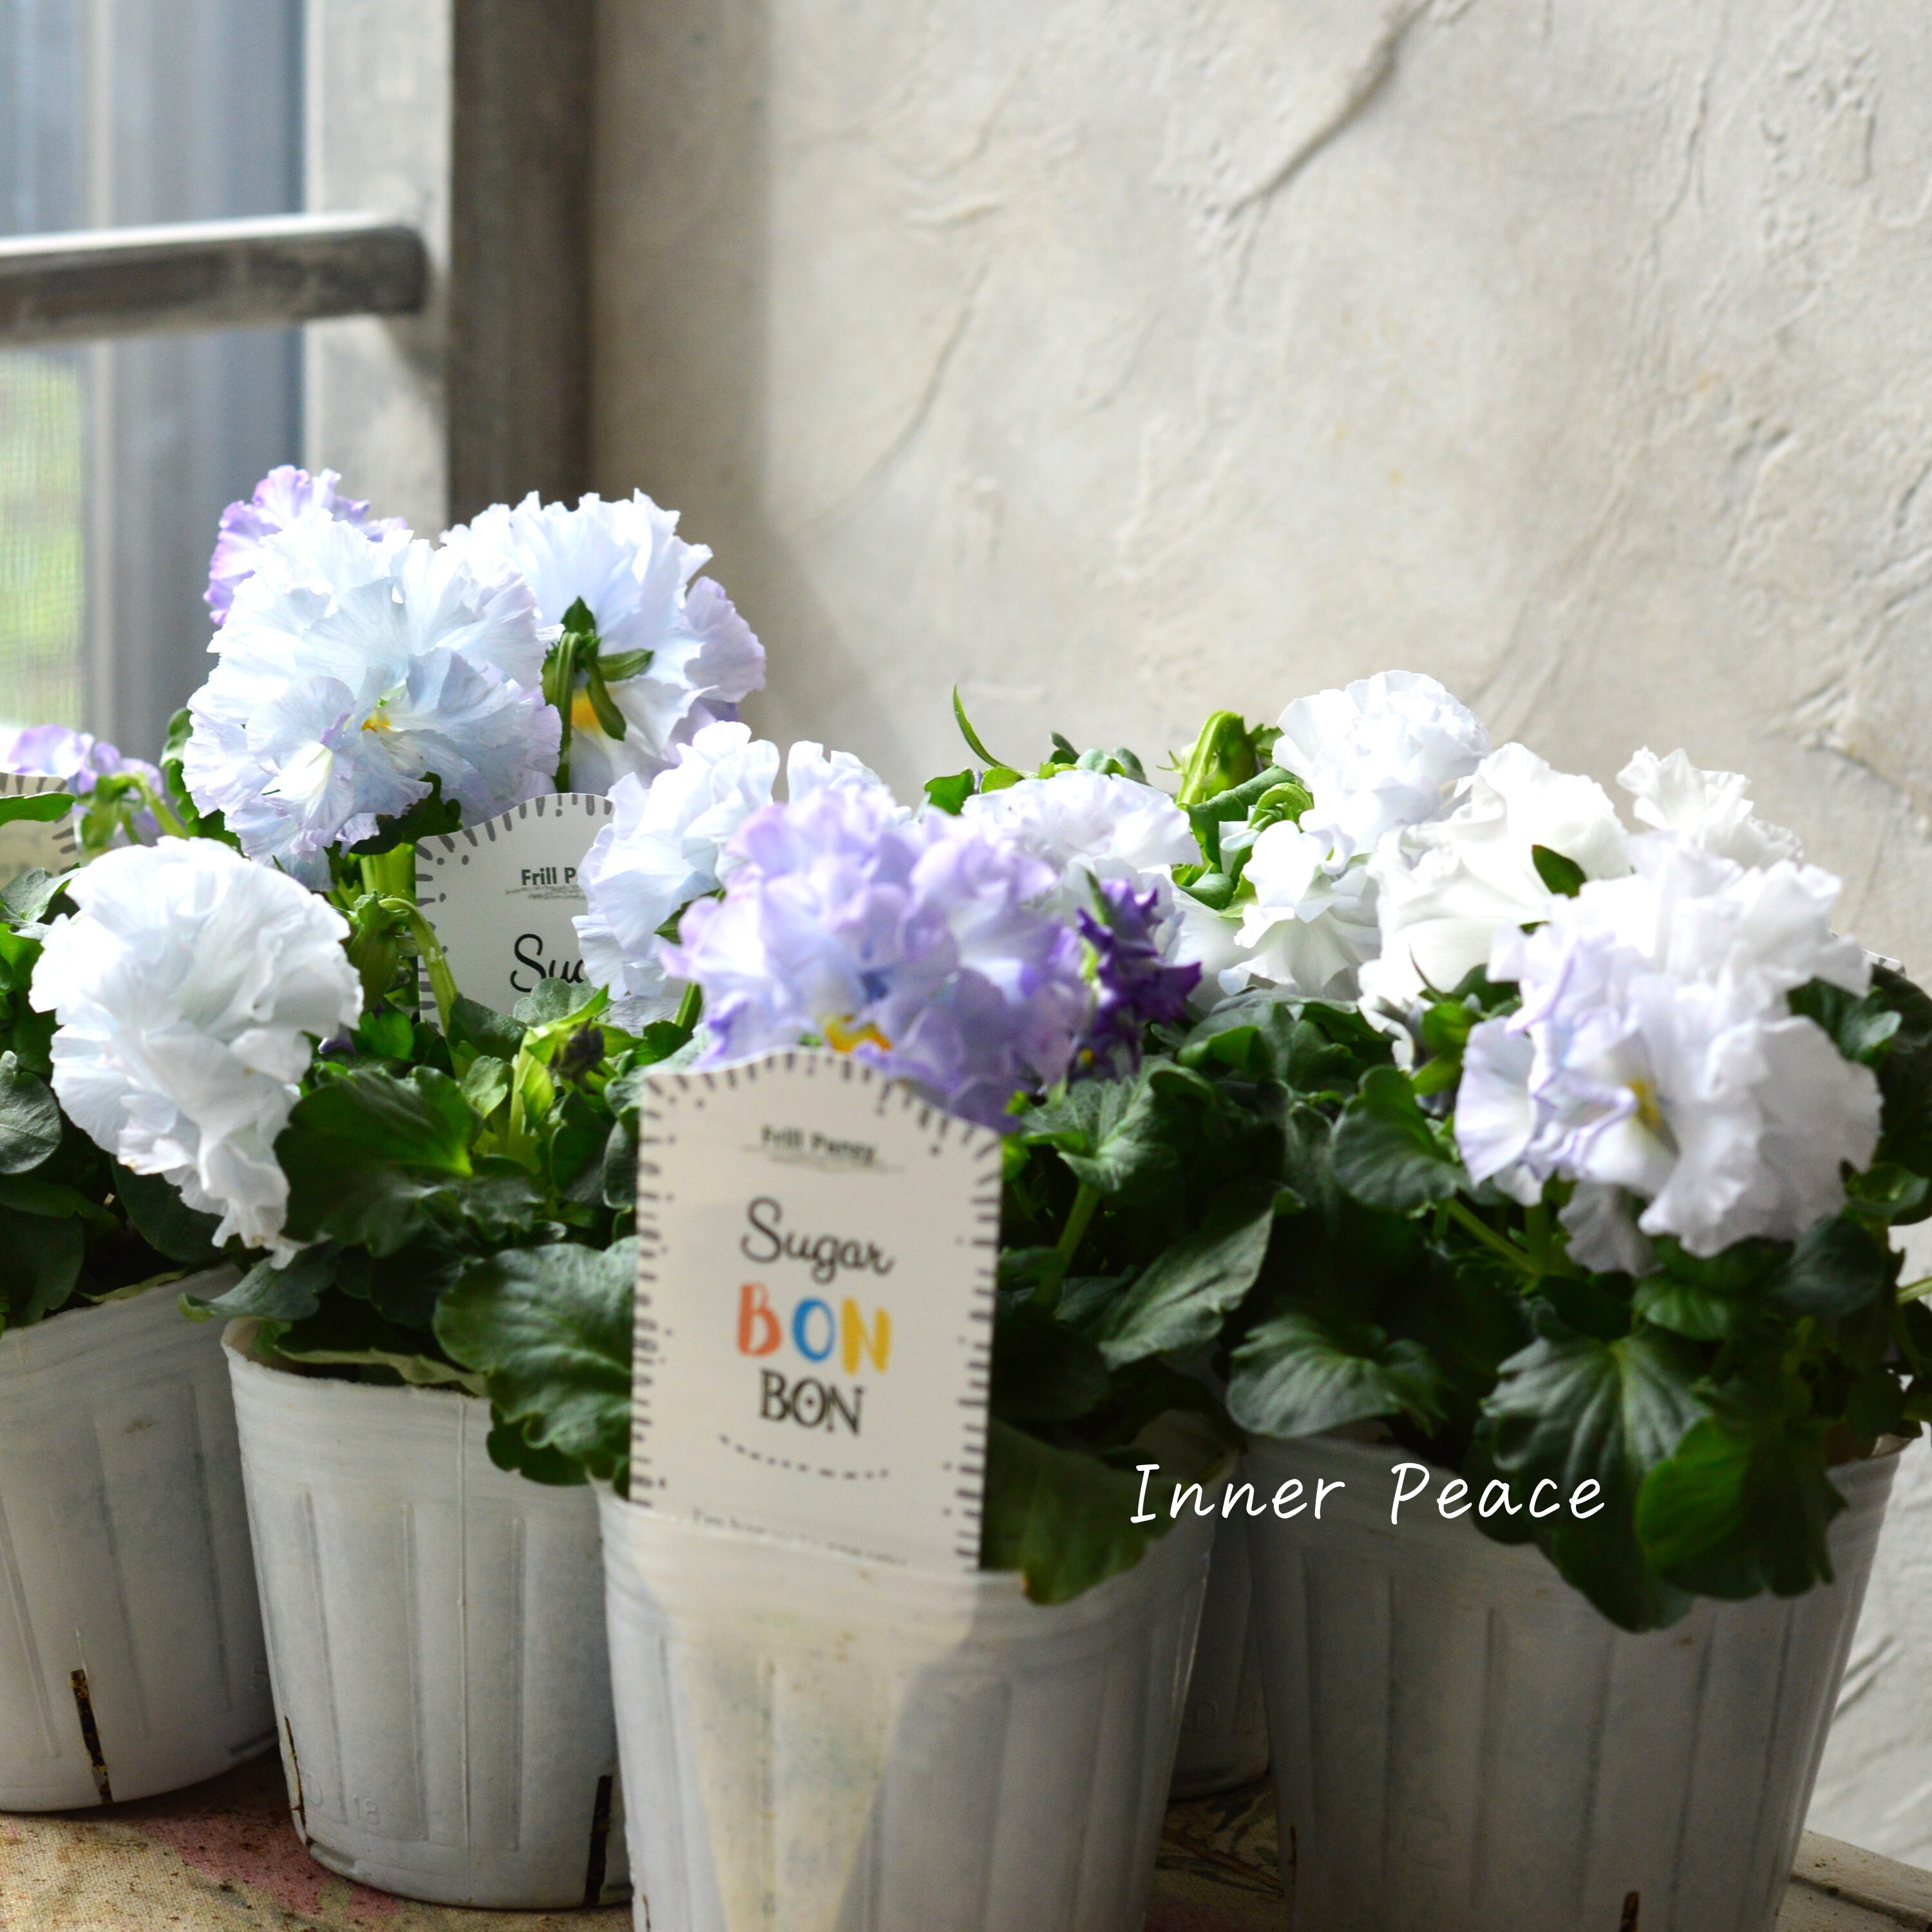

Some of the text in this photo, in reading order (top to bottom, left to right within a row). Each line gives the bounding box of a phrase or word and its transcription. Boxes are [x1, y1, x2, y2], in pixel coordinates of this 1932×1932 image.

[521, 867, 578, 886] Frill P
[741, 1197, 895, 1285] Sugar
[736, 1283, 893, 1376] BON
[760, 1368, 864, 1435] BON
